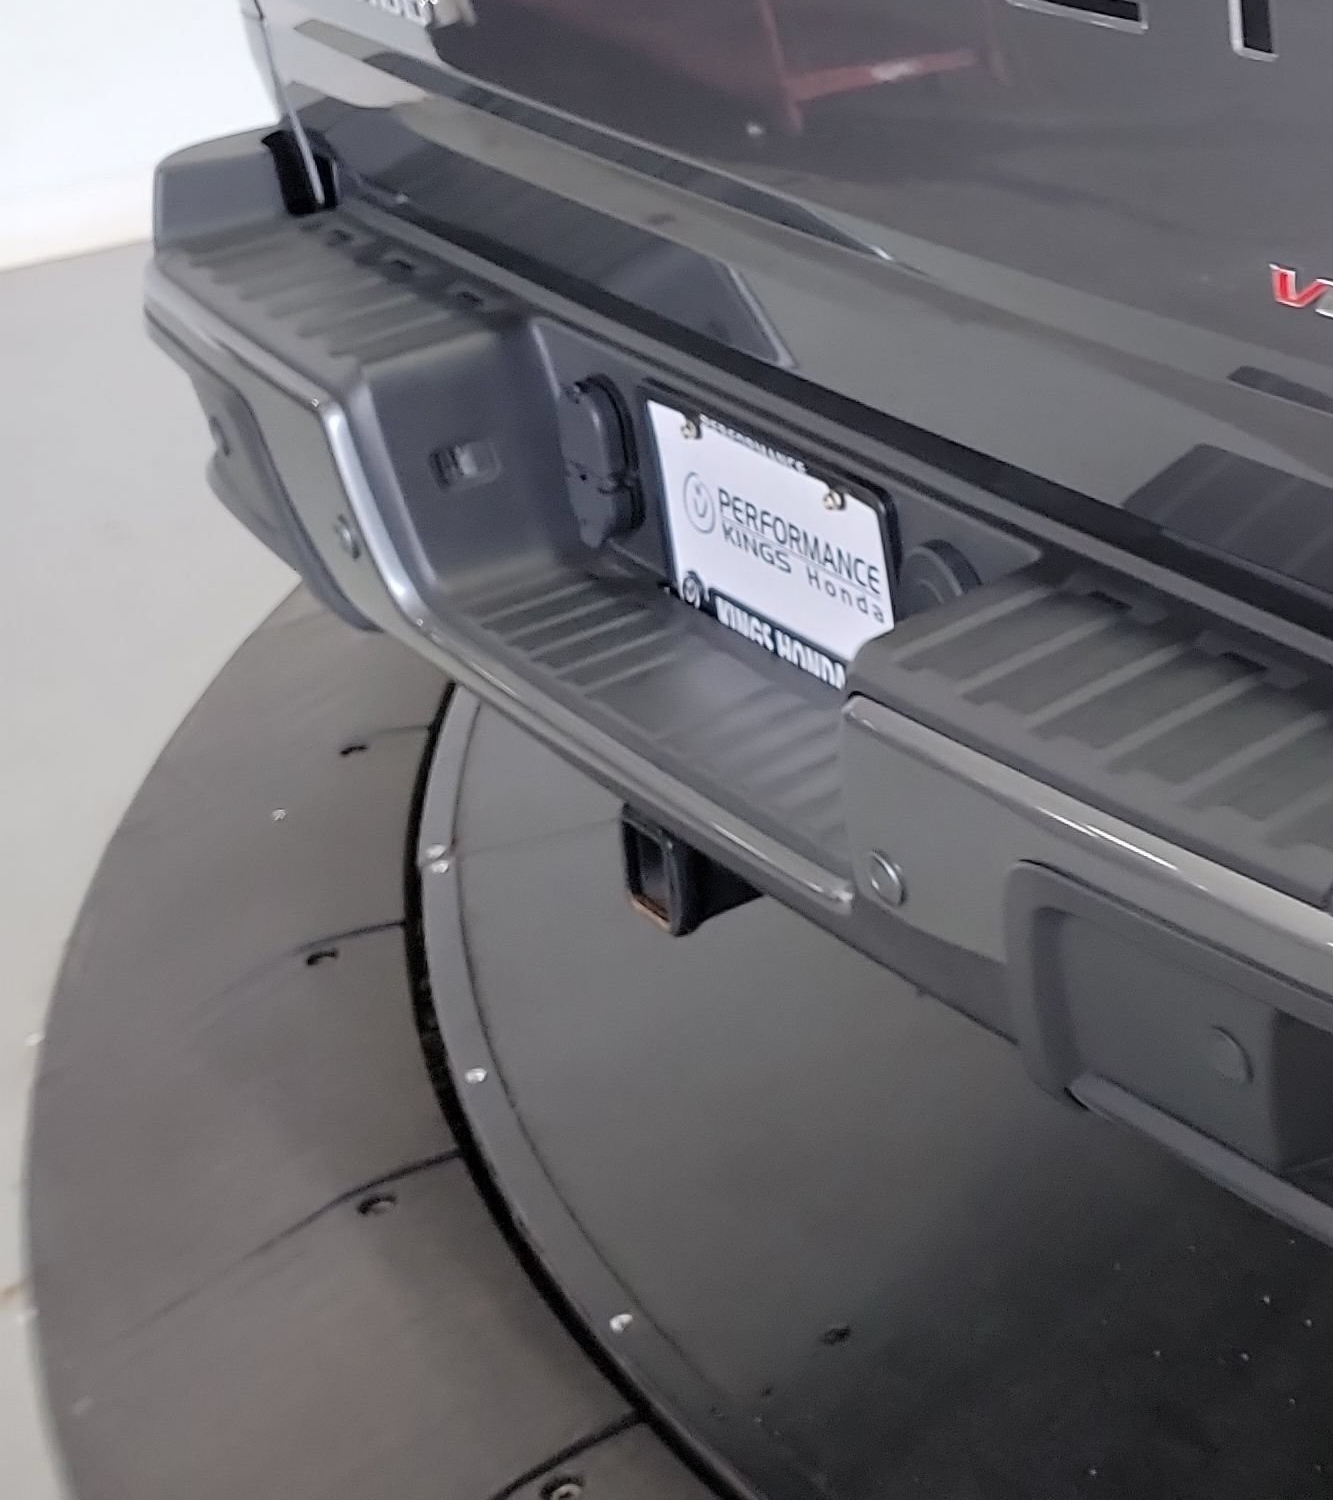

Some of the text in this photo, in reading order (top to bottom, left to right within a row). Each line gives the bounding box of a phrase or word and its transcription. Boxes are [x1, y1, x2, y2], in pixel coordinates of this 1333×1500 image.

[719, 487, 880, 596] PERFORMANCE
[721, 522, 884, 623] KINGS Honda
